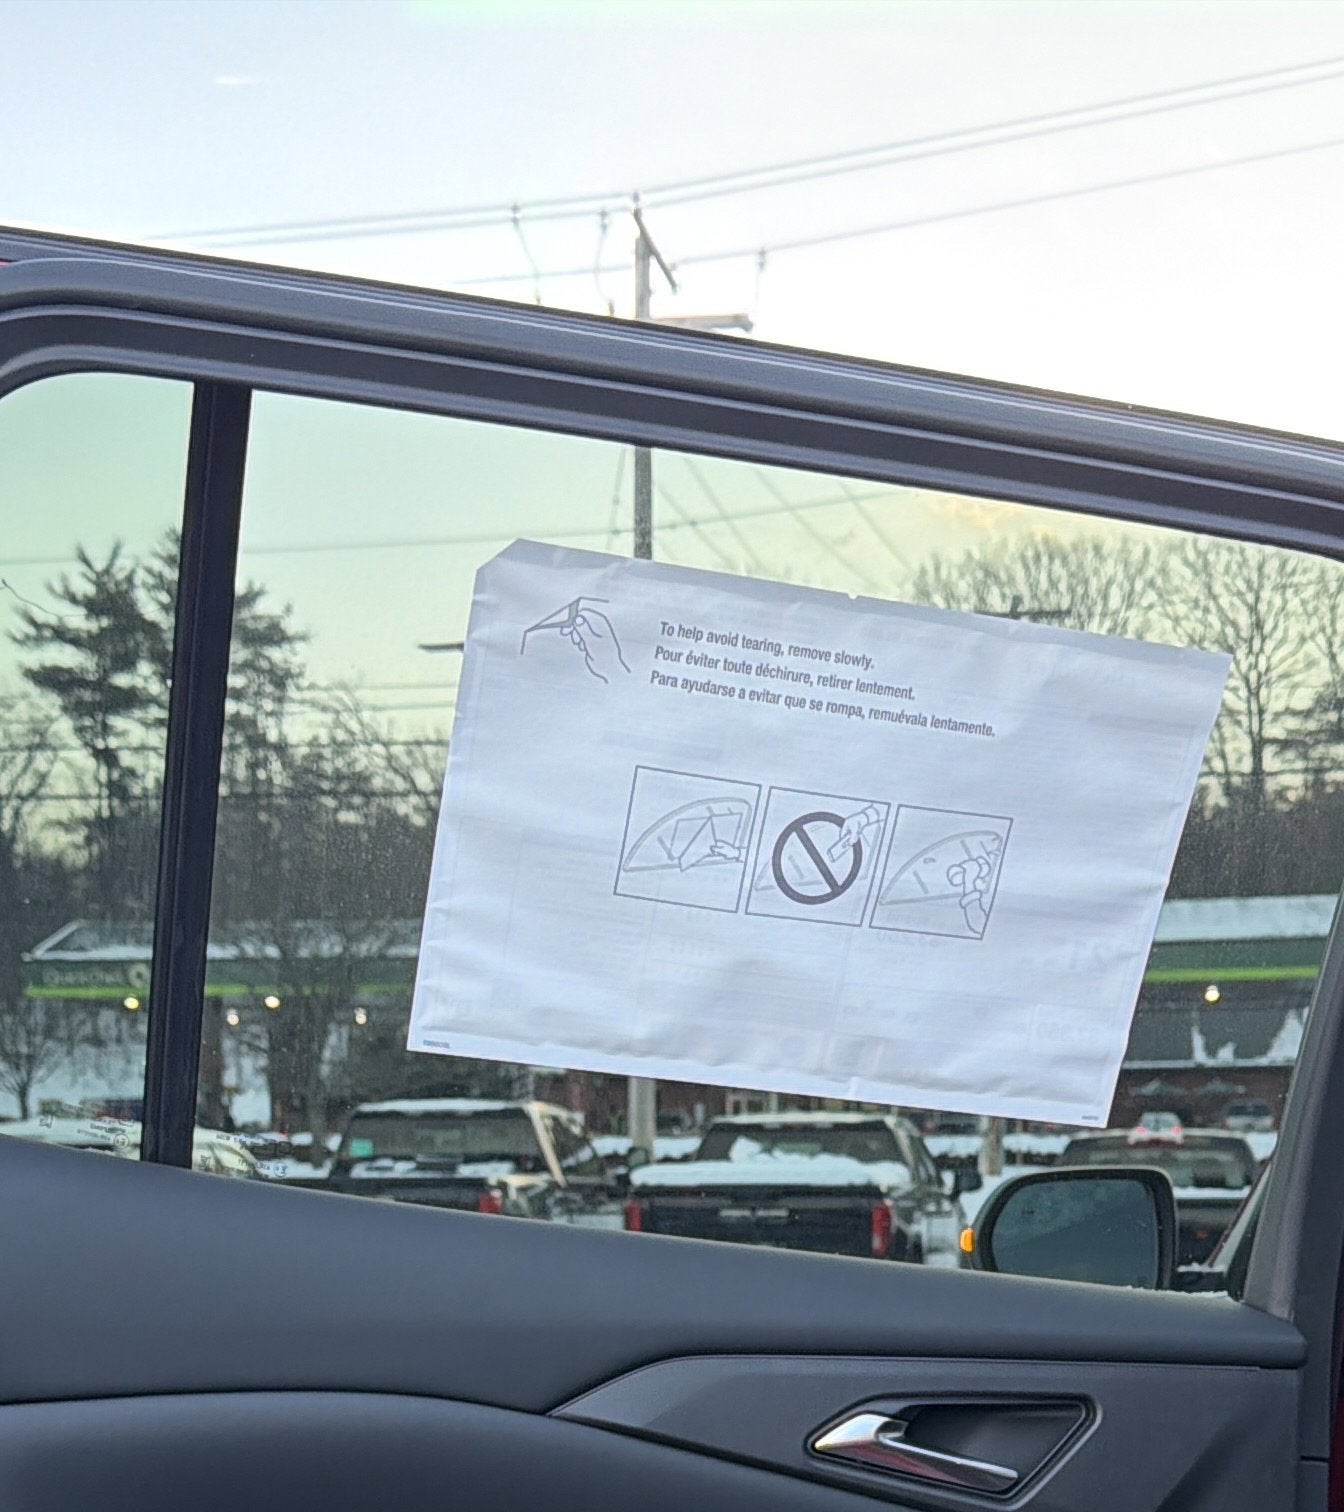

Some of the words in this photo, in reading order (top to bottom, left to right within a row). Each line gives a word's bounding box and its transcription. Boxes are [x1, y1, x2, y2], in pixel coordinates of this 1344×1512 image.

[655, 645, 684, 663] Pour
[686, 650, 721, 670] éviter
[723, 658, 753, 675] toute
[755, 662, 814, 687] déchirure,
[817, 674, 854, 691] retirer
[856, 678, 916, 700] lentement.
[660, 621, 675, 637] To
[677, 623, 704, 644] help
[706, 631, 739, 647] avoid
[741, 635, 785, 657] tearing,
[788, 644, 832, 662] remove
[834, 650, 875, 671] slowly.
[650, 670, 678, 688] Para
[681, 677, 736, 698] ayudarse
[738, 687, 746, 700] a
[748, 687, 783, 705] evitar
[784, 694, 807, 709] que
[809, 699, 824, 711] se
[826, 701, 865, 720] rompa,
[868, 707, 928, 728] remuévala
[930, 714, 996, 737] lentamente.
